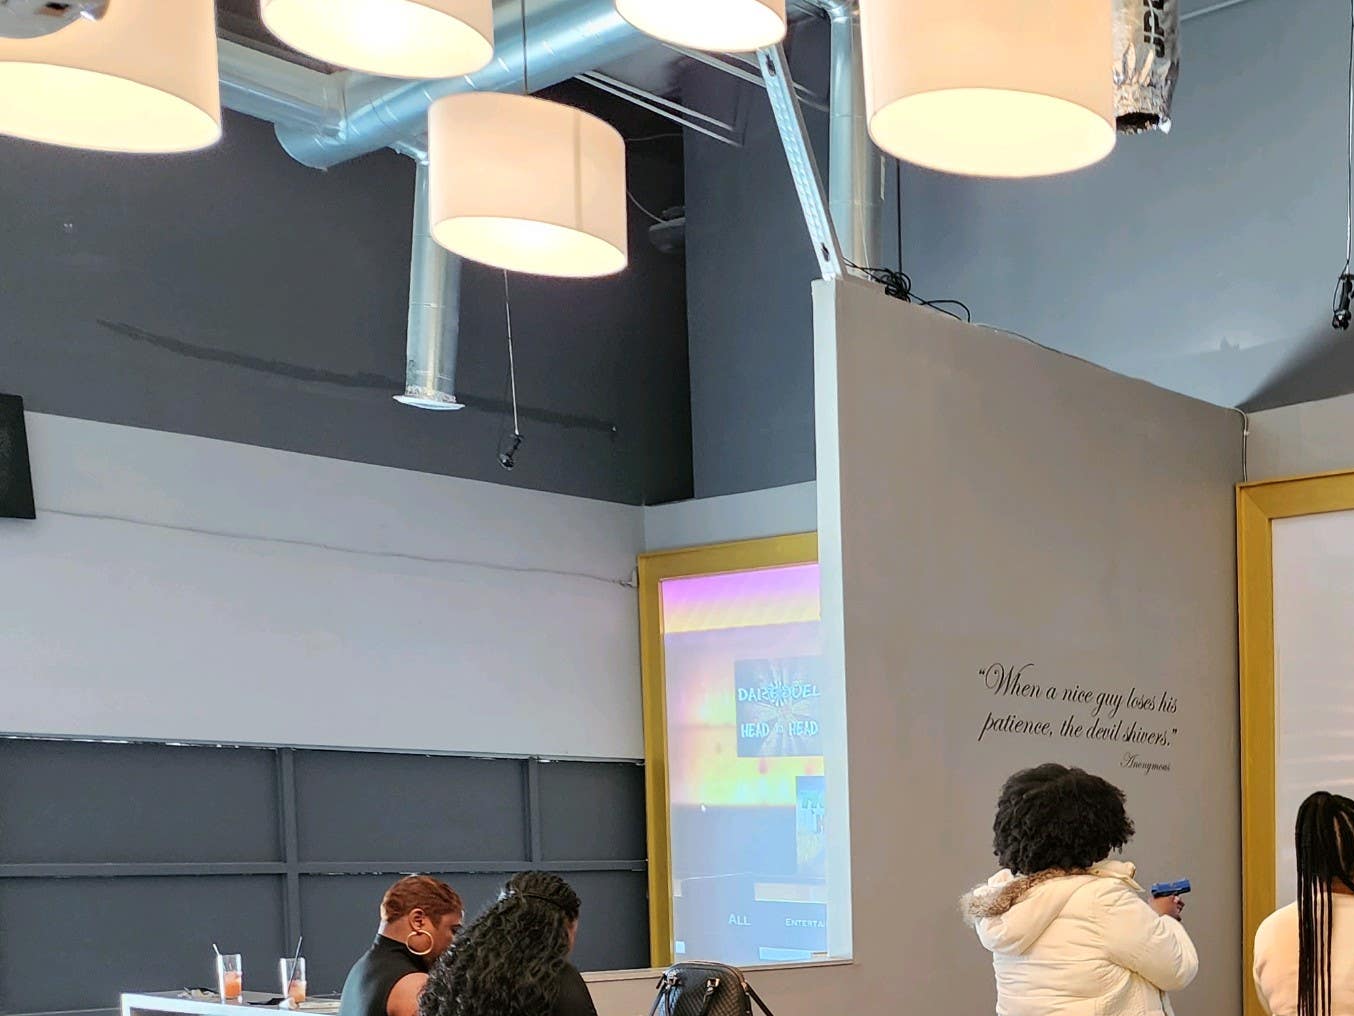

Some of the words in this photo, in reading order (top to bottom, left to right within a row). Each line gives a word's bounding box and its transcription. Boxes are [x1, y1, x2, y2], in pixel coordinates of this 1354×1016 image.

[1046, 686, 1056, 700] a
[1062, 684, 1094, 703] nice
[1091, 692, 1123, 719] guy
[1126, 687, 1155, 711] loses
[1158, 691, 1177, 713] his
[741, 722, 769, 738] HEAD
[788, 719, 819, 736] HEAD
[978, 711, 1053, 741] patience,
[1060, 715, 1083, 738] the
[1086, 717, 1122, 742] devil
